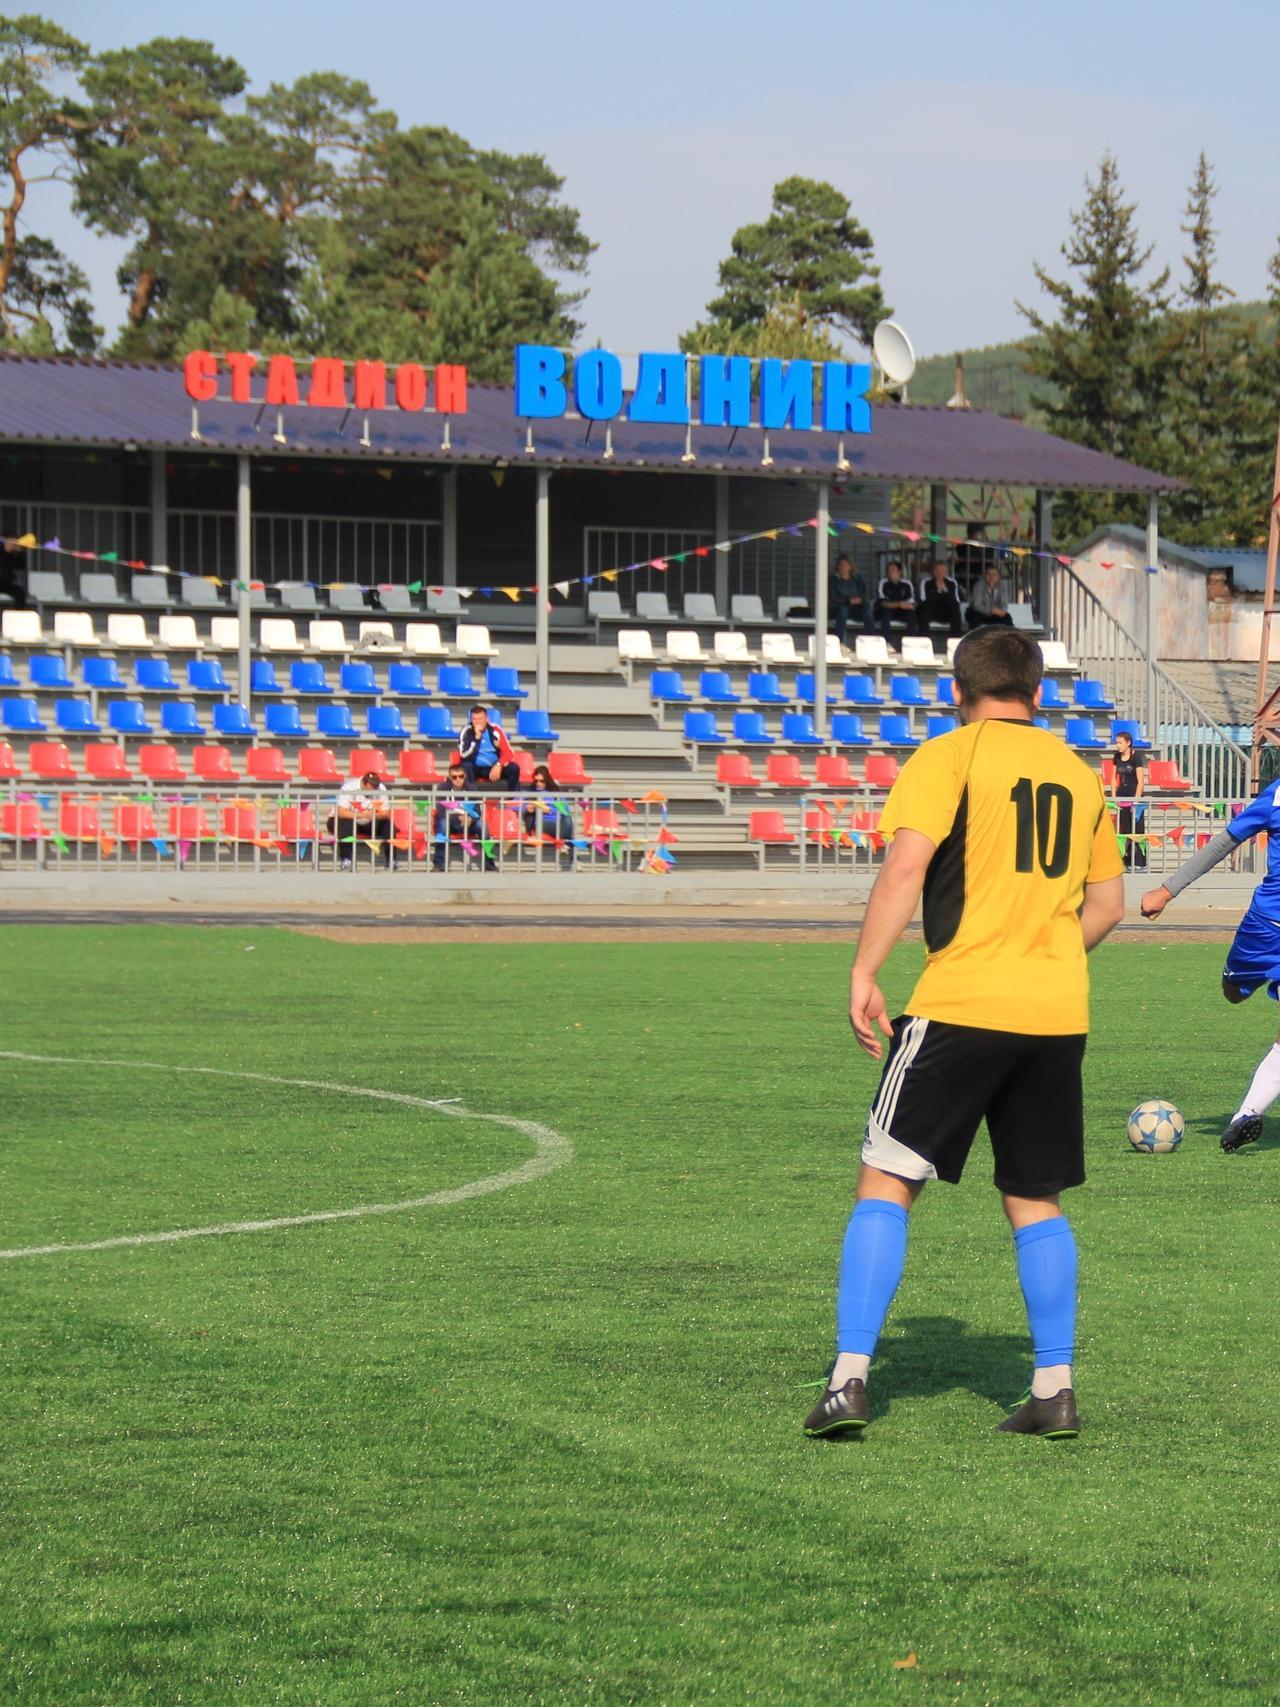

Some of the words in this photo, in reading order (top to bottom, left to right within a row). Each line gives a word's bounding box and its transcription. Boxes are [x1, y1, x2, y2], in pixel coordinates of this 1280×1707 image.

[183, 349, 468, 414] СТАДИОН
[514, 343, 872, 434] ВОДНИК
[1010, 777, 1073, 880] 10
